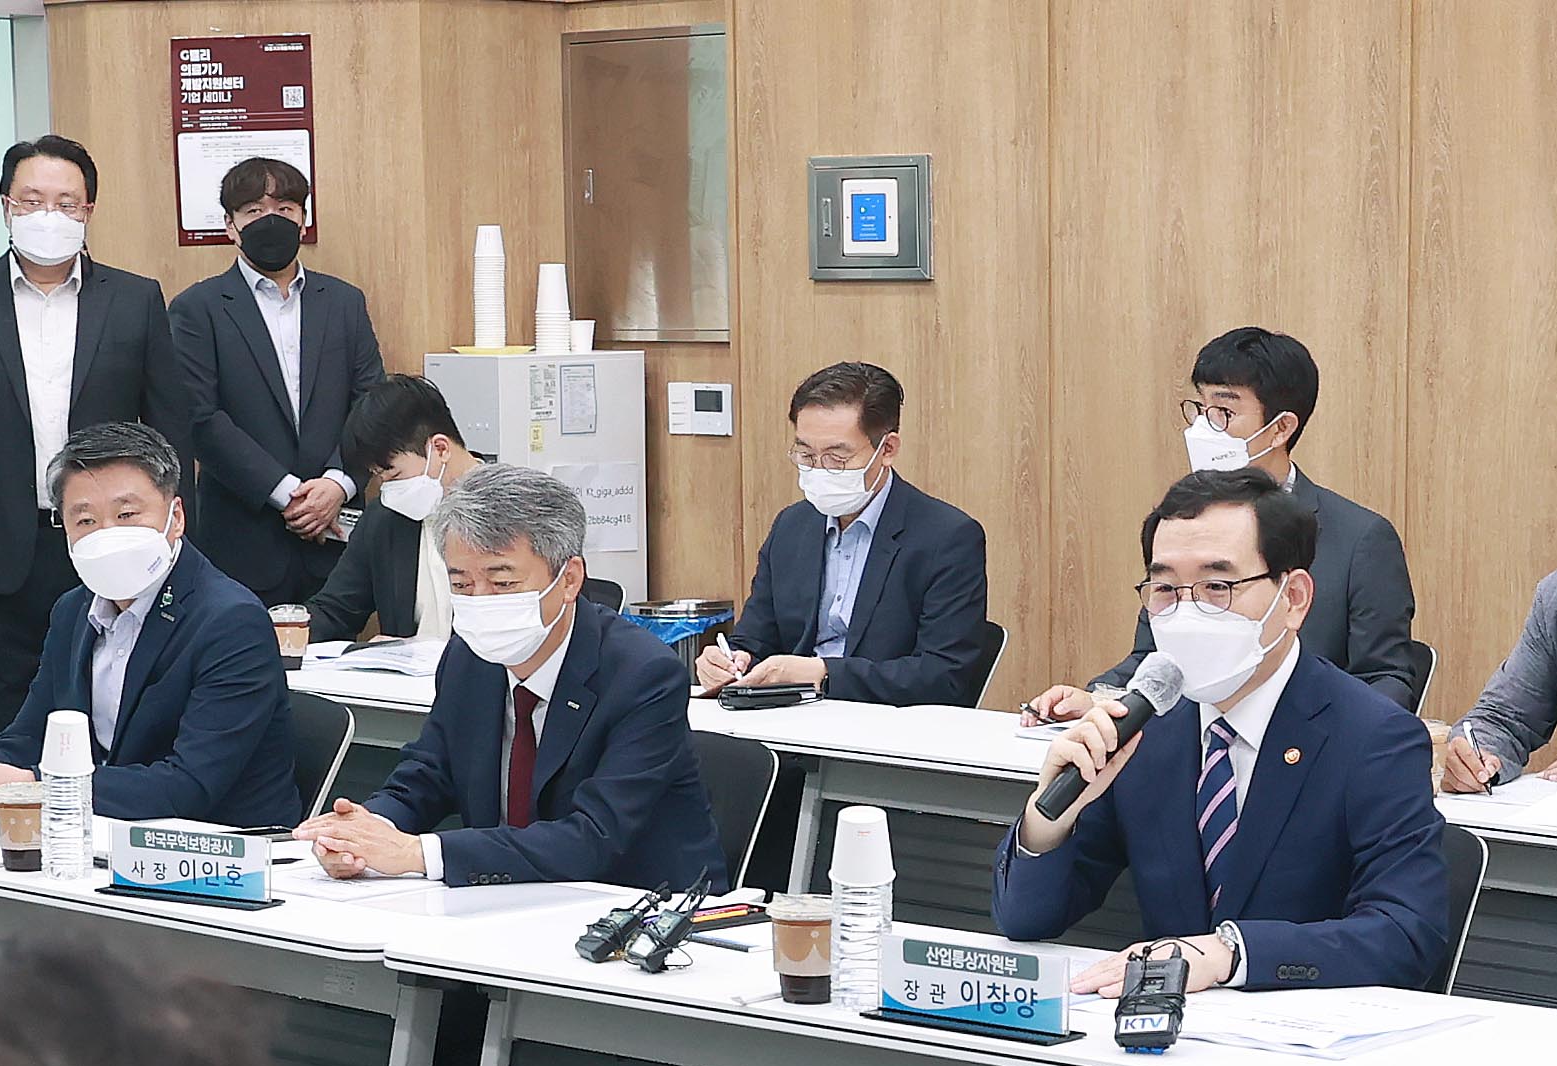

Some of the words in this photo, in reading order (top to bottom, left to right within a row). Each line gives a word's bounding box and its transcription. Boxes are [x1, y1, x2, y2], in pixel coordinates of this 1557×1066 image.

[181, 92, 201, 104] 기업
[202, 91, 232, 103] 세미나
[144, 831, 234, 856] 한국무역보험공사
[179, 859, 244, 887] 이인호
[926, 945, 1018, 975] 산업통상자원부
[960, 979, 1039, 1019] 이창양
[1124, 1016, 1165, 1030] KTV
